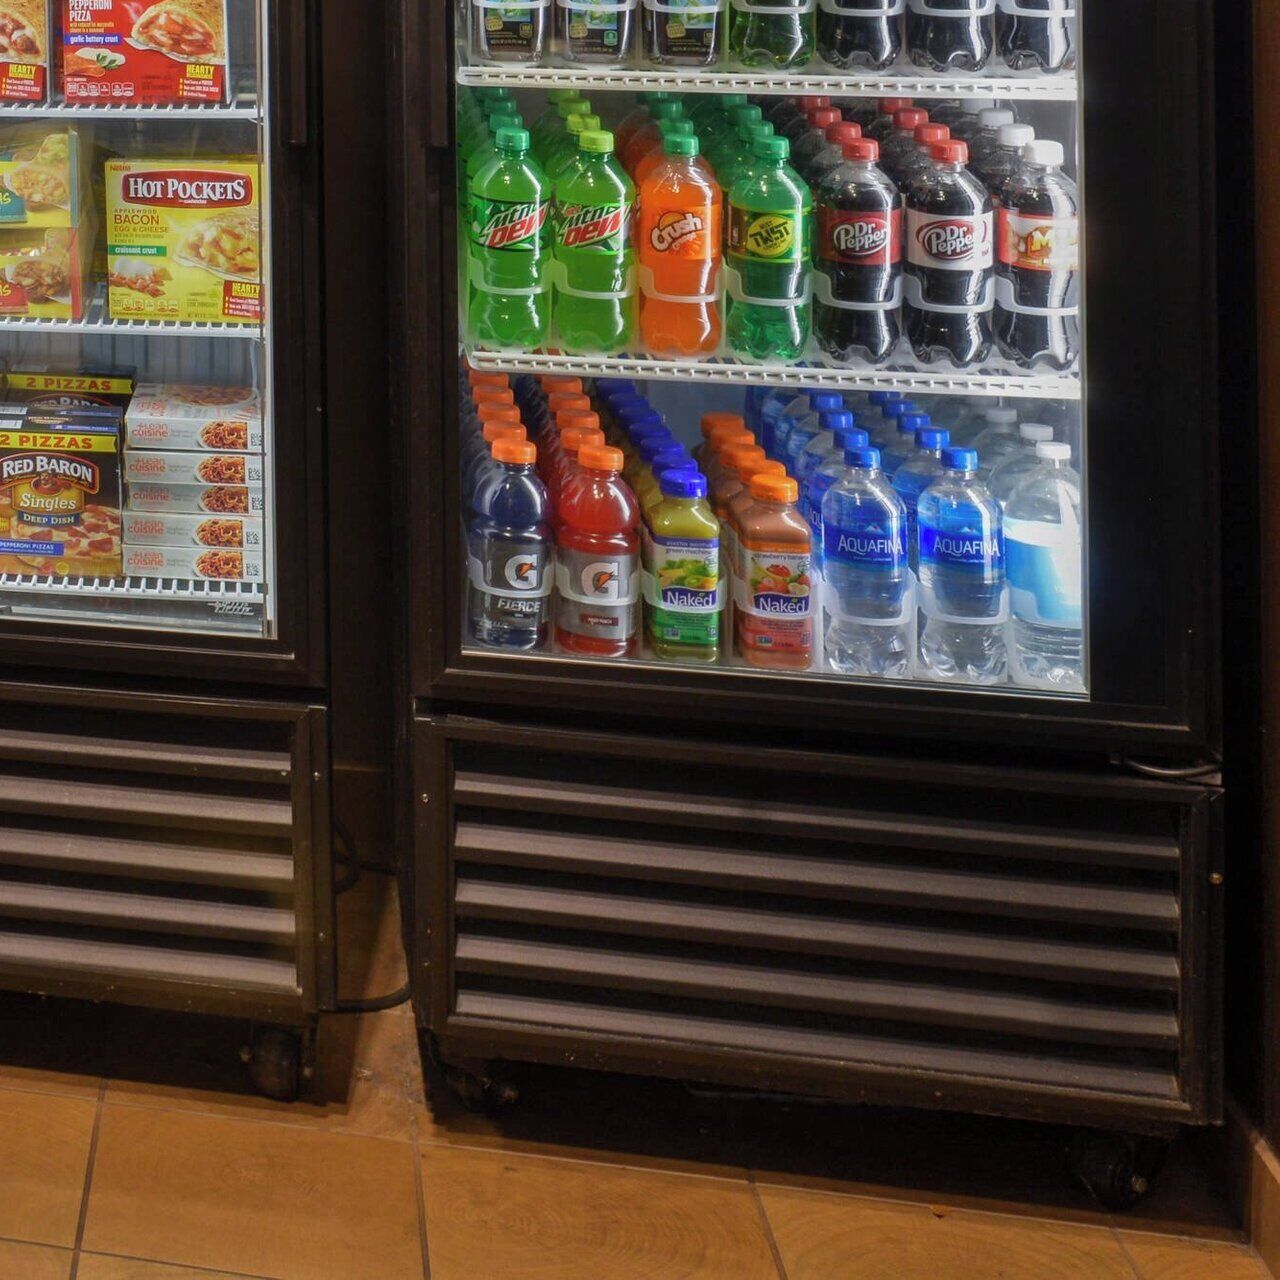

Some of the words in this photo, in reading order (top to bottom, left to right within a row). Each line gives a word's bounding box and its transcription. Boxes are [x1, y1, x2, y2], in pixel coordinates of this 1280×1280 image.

[69, 11, 91, 21] PIZZA
[128, 178, 165, 198] HOT
[167, 178, 245, 200] POCKETS
[114, 215, 160, 225] BACON
[651, 212, 703, 252] Crush
[834, 224, 887, 249] Pepper
[854, 222, 875, 235] Dr
[947, 225, 967, 241] Dr
[931, 227, 974, 254] Peppe
[44, 378, 111, 391] PIZZAS
[132, 429, 169, 437] cuisine
[19, 435, 93, 449] PIZZAS
[2, 458, 34, 478] RED
[36, 456, 92, 482] BARON
[129, 463, 166, 472] cuisine
[20, 493, 76, 510] Singles
[133, 492, 169, 501] cuisine
[23, 513, 48, 523] DEEP
[51, 515, 74, 523] DISH
[127, 526, 165, 535] cuisine
[839, 534, 903, 556] AQUAFINA
[934, 536, 1000, 558] AQUAFINA
[505, 554, 538, 590] G
[581, 562, 620, 599] G
[497, 599, 540, 613] FIERCE
[666, 591, 713, 607] Naked
[759, 597, 806, 613] Naked
